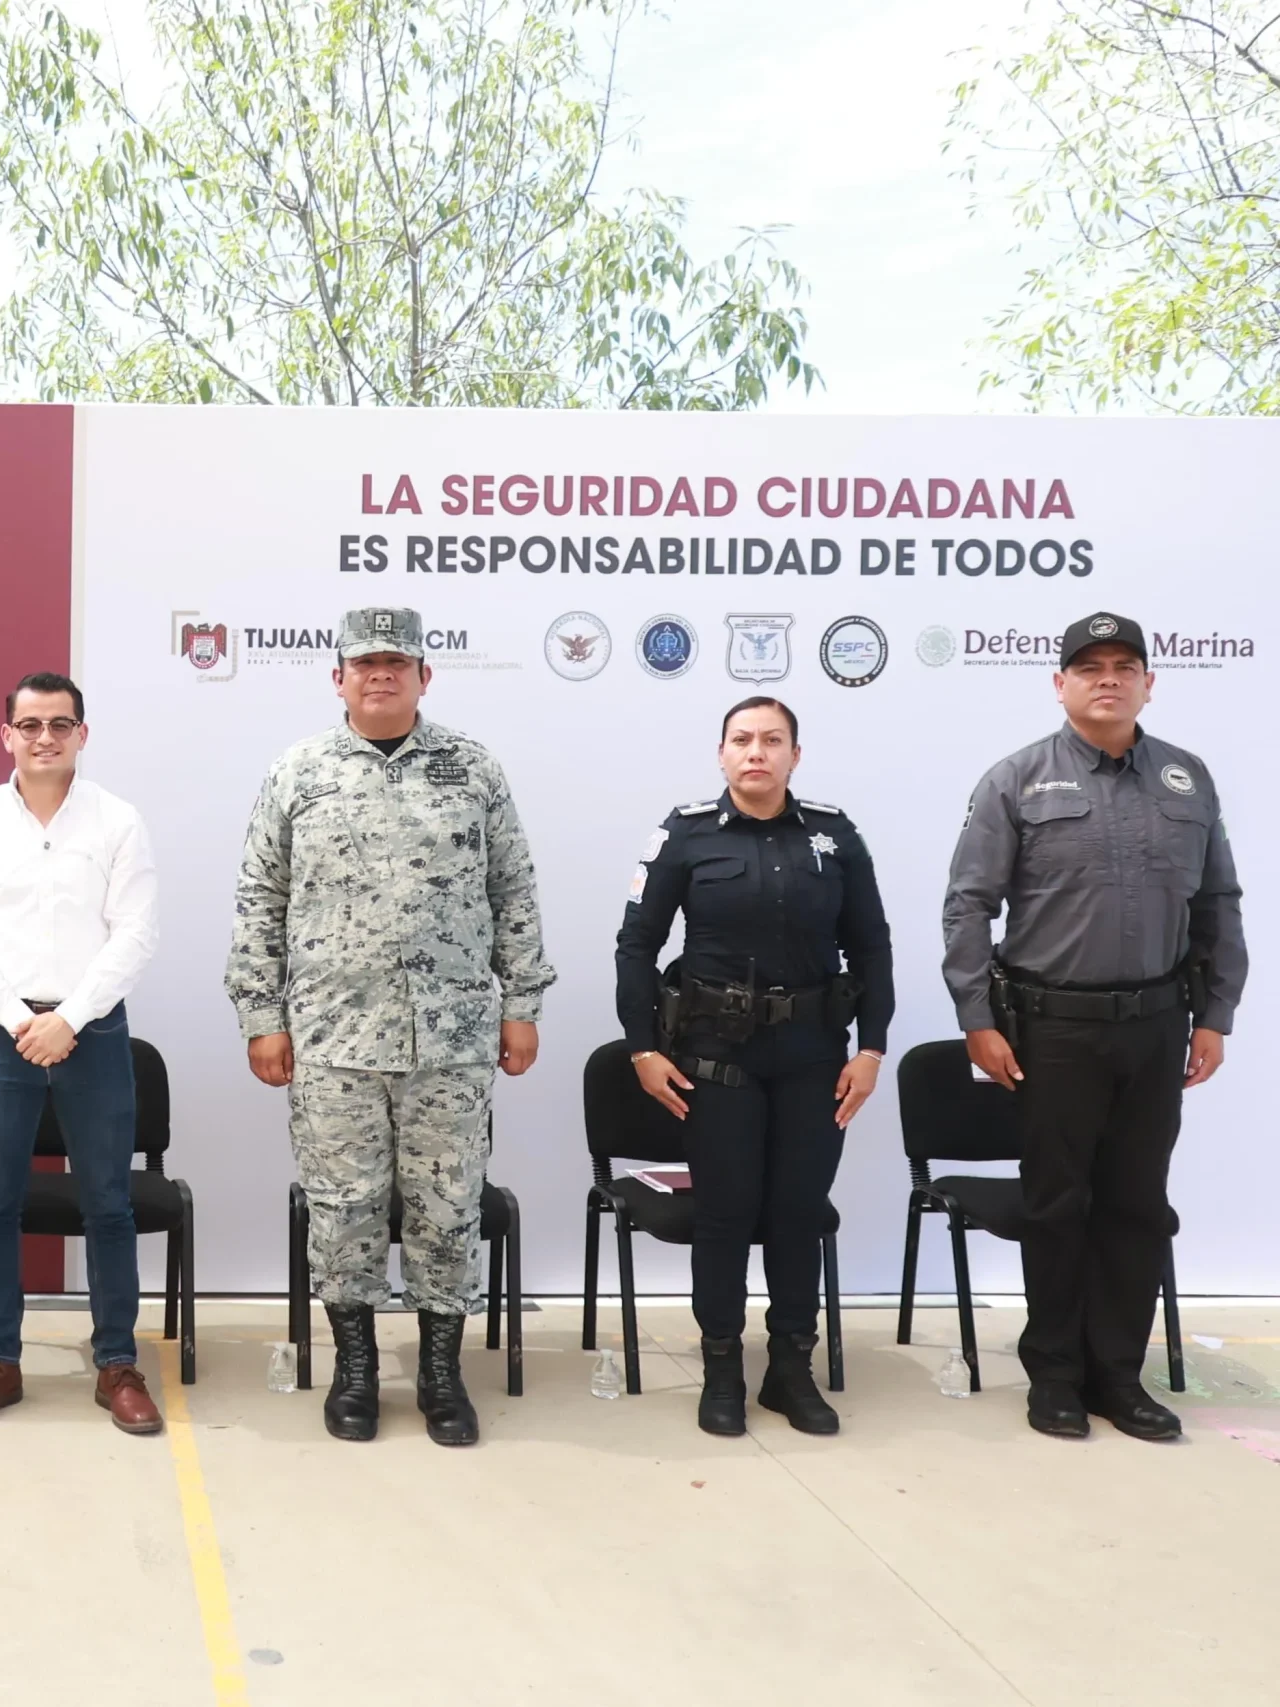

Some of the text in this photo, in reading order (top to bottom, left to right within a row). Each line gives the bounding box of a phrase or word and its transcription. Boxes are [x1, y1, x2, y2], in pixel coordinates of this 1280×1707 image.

[361, 473, 1076, 520] LA SEGURIDAD CIUDADANA
[339, 534, 1094, 578] ES RESPONSABILIDAD DE TODOS
[244, 628, 340, 649] TIJUAN
[832, 641, 876, 653] SSPC
[1152, 631, 1254, 657] Marina
